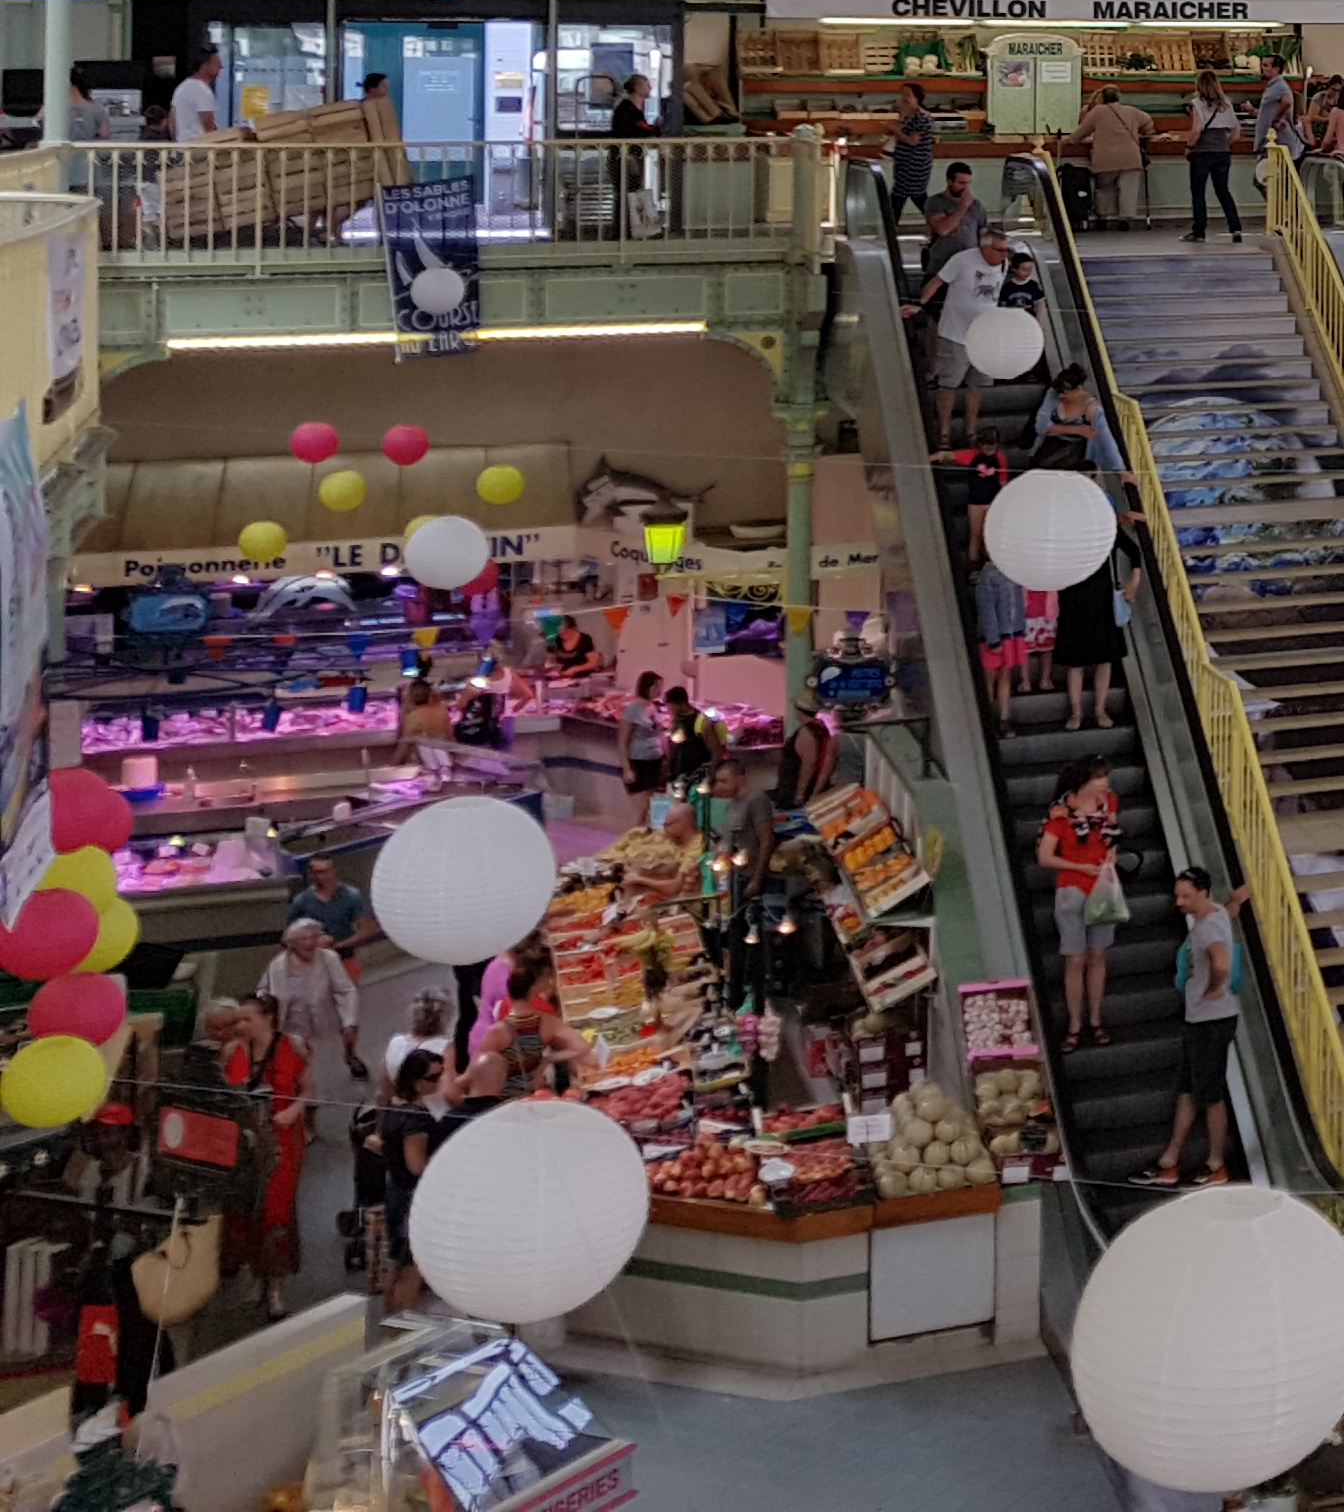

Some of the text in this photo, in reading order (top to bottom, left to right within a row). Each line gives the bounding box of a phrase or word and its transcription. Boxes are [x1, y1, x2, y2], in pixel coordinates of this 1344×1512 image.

[1008, 42, 1063, 55] MARAICHER
[384, 179, 469, 201] LES SABLES
[385, 193, 470, 215] D'OLONNE
